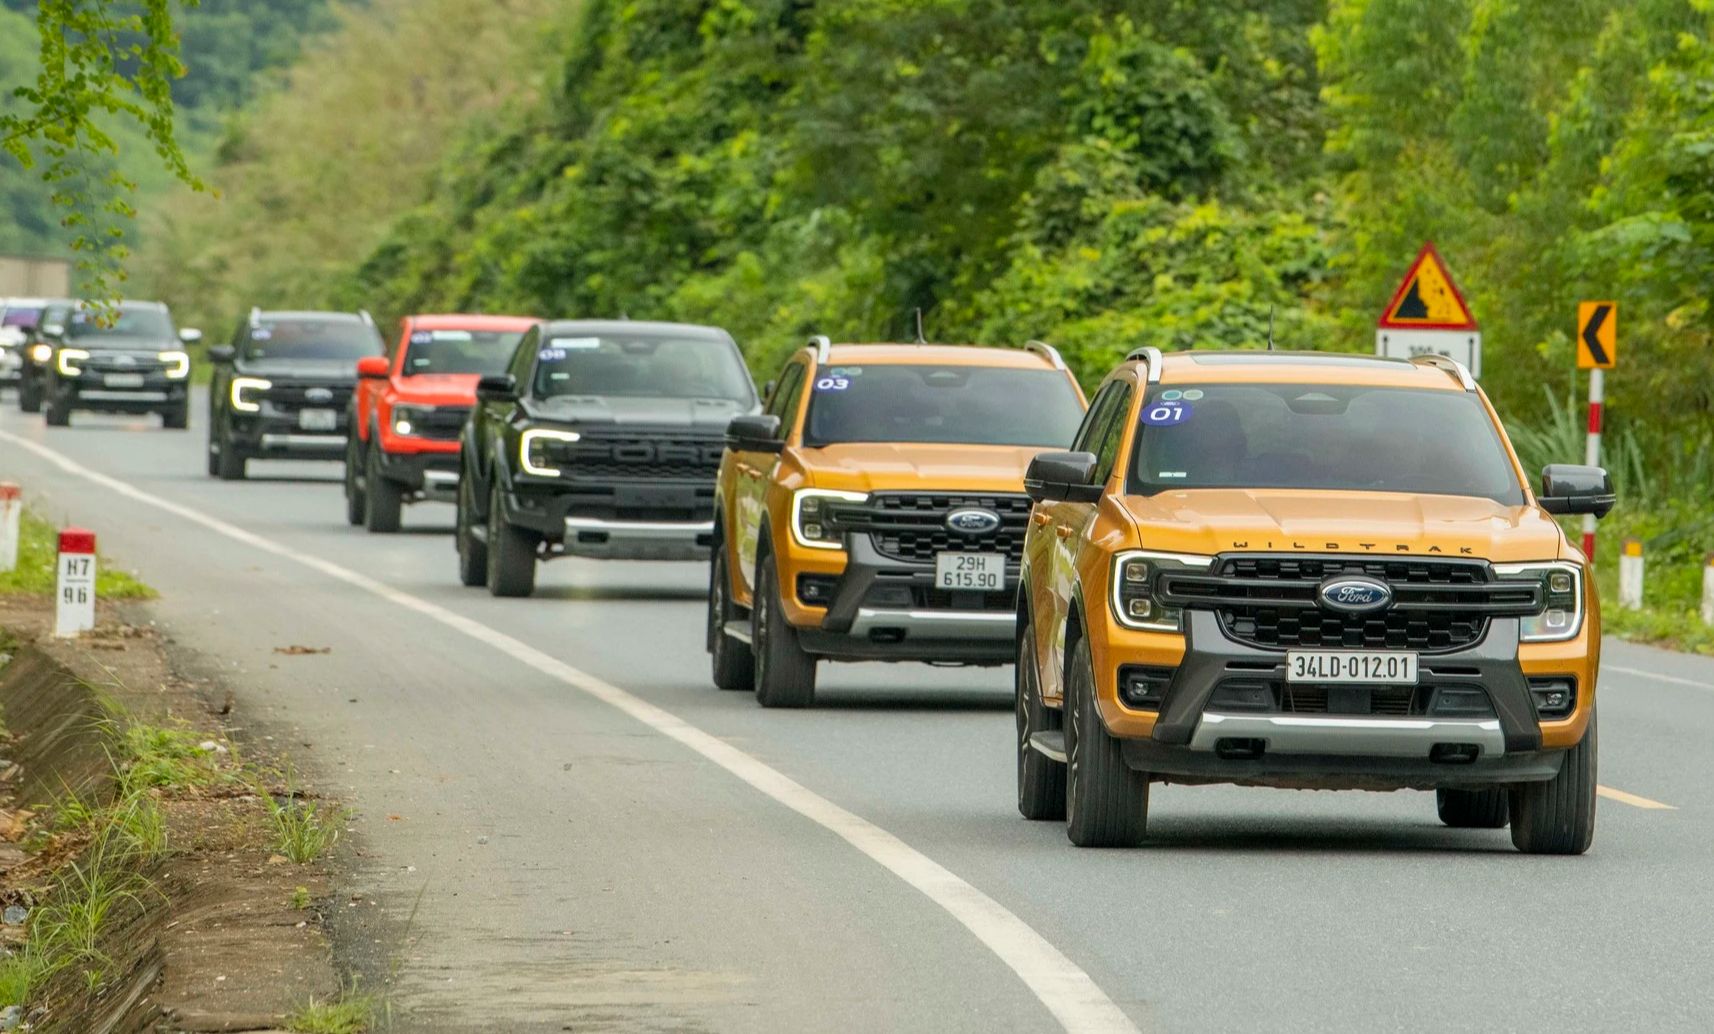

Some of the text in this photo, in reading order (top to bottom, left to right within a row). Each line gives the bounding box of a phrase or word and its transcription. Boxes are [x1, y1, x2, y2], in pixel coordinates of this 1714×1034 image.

[817, 378, 849, 389] 03
[1150, 407, 1183, 421] 01
[960, 514, 986, 527] Ford
[1233, 541, 1473, 554] WILDTRAK
[67, 558, 90, 576] H7
[957, 556, 986, 571] 29H
[943, 571, 997, 587] 615.90
[64, 586, 87, 604] 96
[1337, 586, 1373, 603] Ford
[1295, 656, 1408, 679] 34LD-012.01
